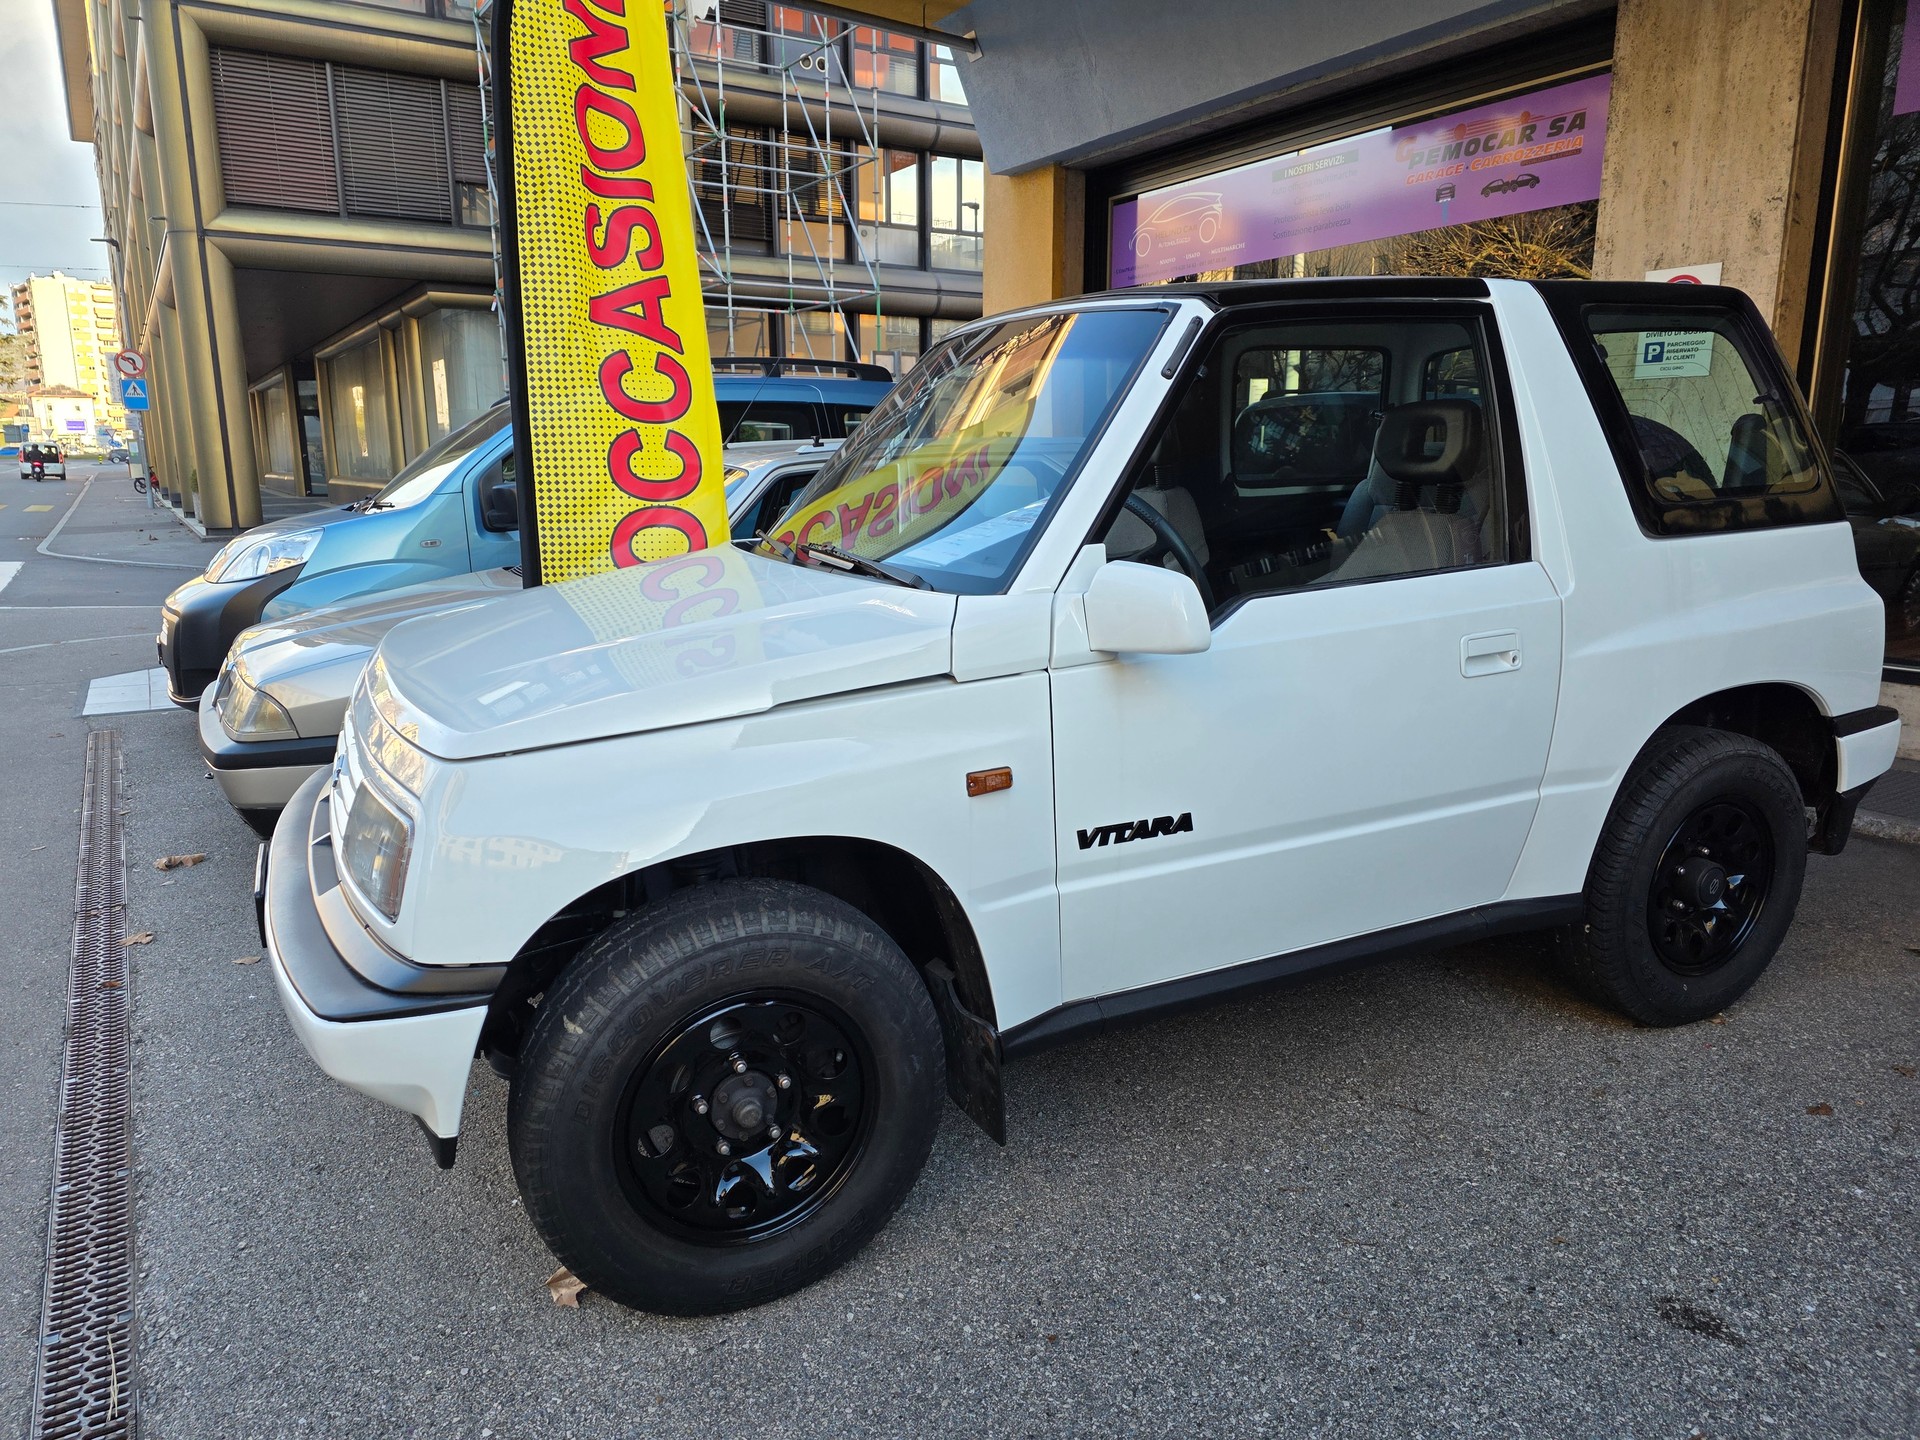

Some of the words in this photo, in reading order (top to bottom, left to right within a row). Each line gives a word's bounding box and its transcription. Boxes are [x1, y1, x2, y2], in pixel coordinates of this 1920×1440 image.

[1408, 123, 1538, 170] PEMOCAR
[1547, 111, 1587, 138] SA
[1288, 162, 1314, 177] NOSTRI
[1315, 154, 1345, 170] SERVIZI:
[1406, 163, 1465, 186] GARAGE
[1469, 135, 1584, 172] CARROZZERIA
[1272, 227, 1313, 241] Sostituzione
[1313, 217, 1352, 233] parabrezza
[1185, 251, 1201, 260] USATO
[1210, 242, 1247, 255] MULTIMARCHE
[1666, 346, 1699, 354] RISERVATO
[1667, 339, 1706, 348] PARCHEGGIO
[1076, 812, 1194, 850] VITARA
[572, 946, 792, 1126] DISCOVERER
